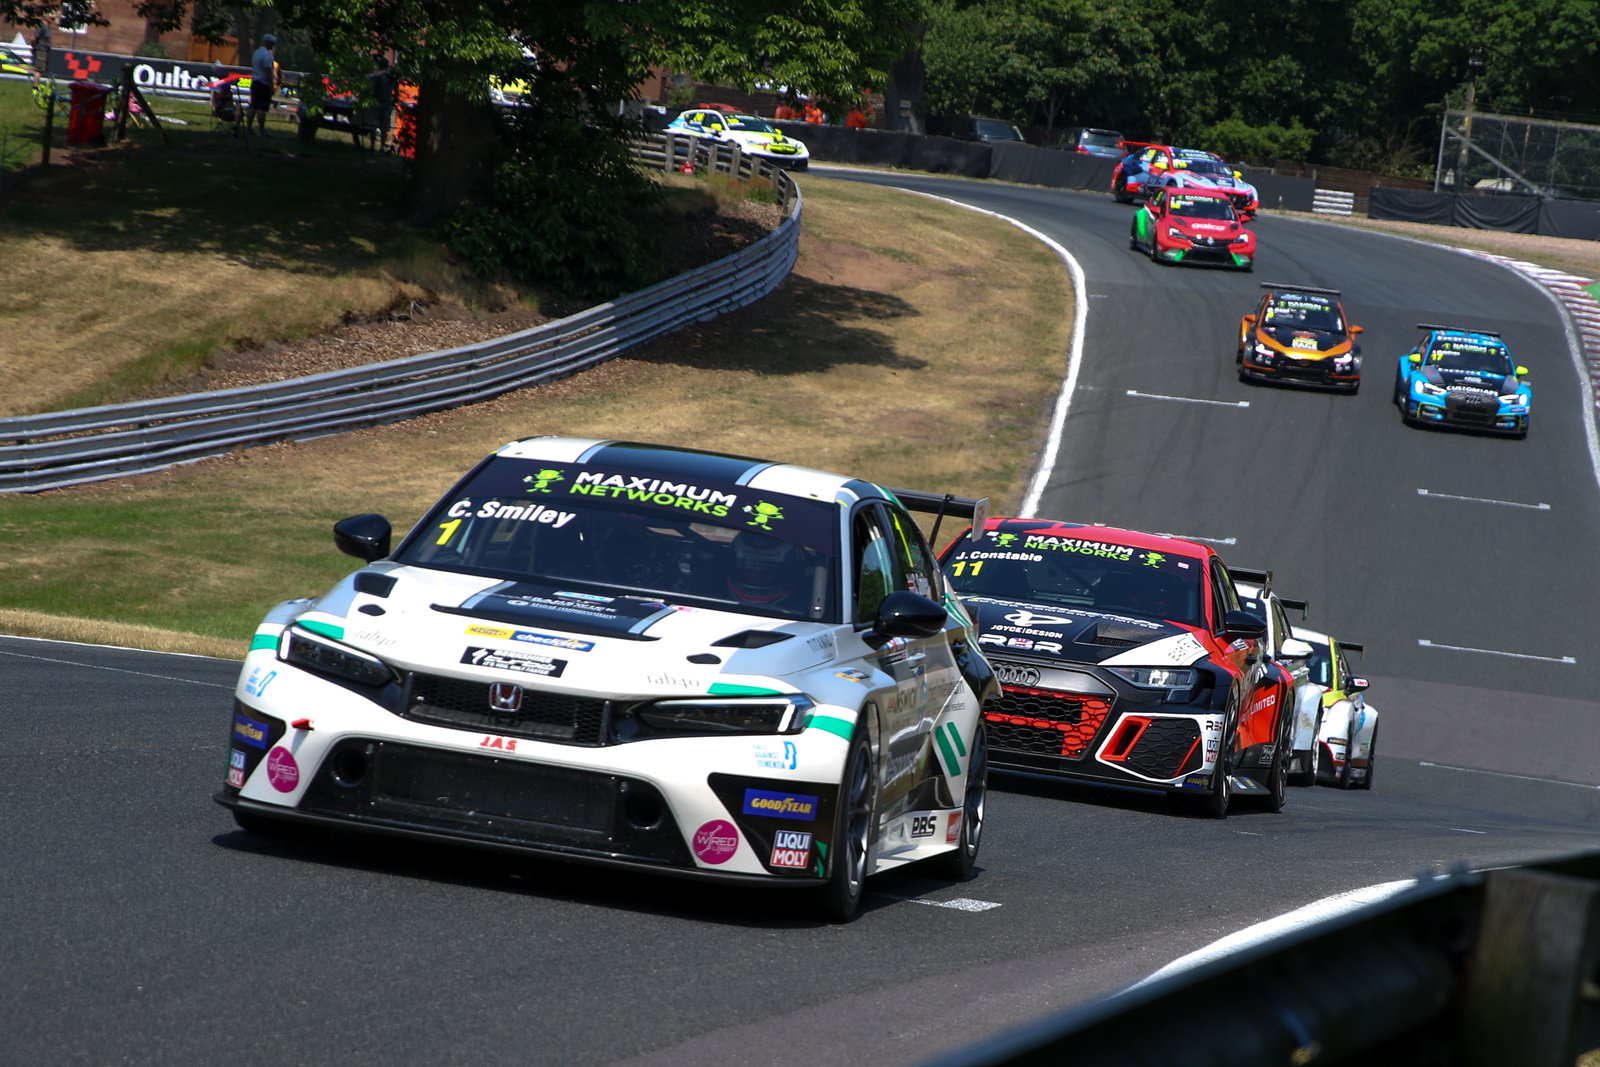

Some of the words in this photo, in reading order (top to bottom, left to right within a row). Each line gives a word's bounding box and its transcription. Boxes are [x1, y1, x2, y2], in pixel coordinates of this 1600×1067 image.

[569, 483, 729, 517] NETWORKS
[575, 472, 737, 507] MAXIMUM
[448, 500, 472, 517] C.
[477, 501, 576, 528] Smiley
[436, 519, 462, 545] 1
[1024, 542, 1131, 561] NETWORKS
[1026, 535, 1134, 556] MAXIMUM
[952, 561, 984, 577] 11
[978, 633, 1064, 655] RBR
[1250, 694, 1276, 715] LIMITED
[480, 736, 517, 750] JAS
[751, 798, 812, 814] GOODYEAR
[776, 833, 811, 850] LIQUI
[773, 849, 808, 866] MOLY
